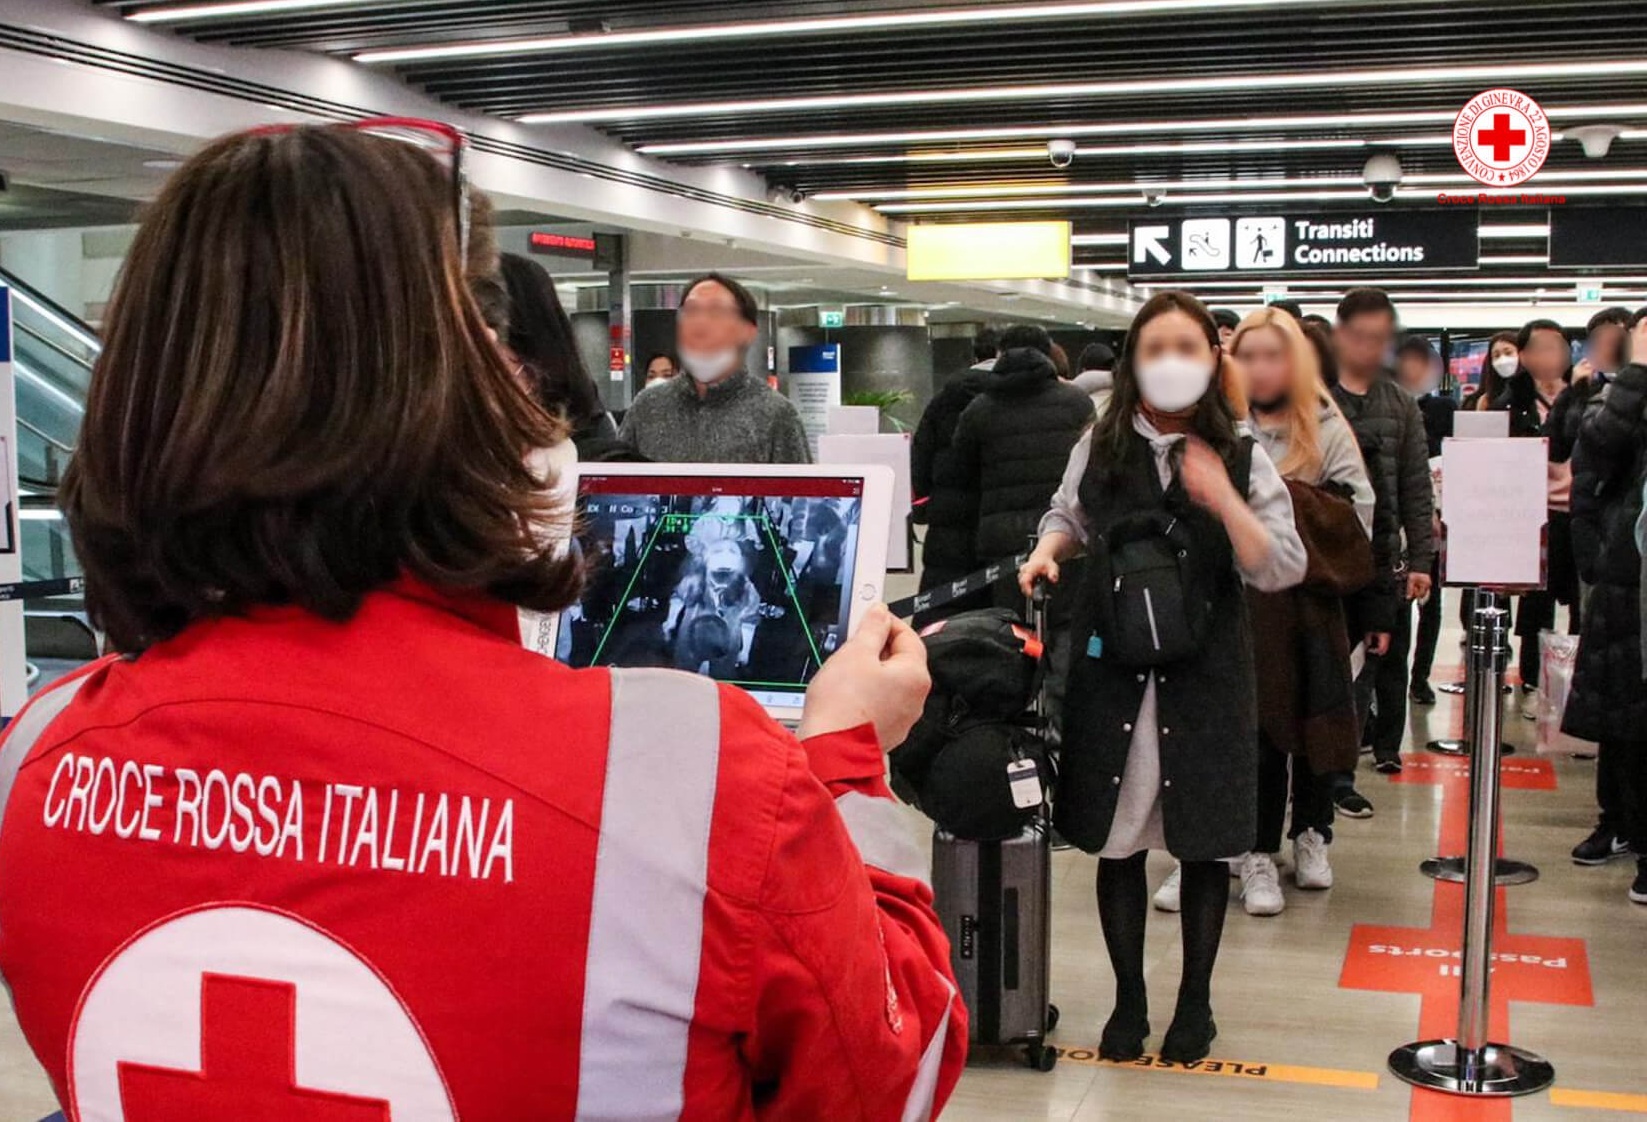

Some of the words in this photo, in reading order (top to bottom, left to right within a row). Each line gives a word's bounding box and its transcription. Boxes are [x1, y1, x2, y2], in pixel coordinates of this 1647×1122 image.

[1295, 218, 1374, 240] Transiti
[1295, 242, 1424, 264] Connections
[43, 752, 165, 842] CROCE
[174, 768, 304, 862] ROSSA
[318, 784, 514, 883] ITALIANA
